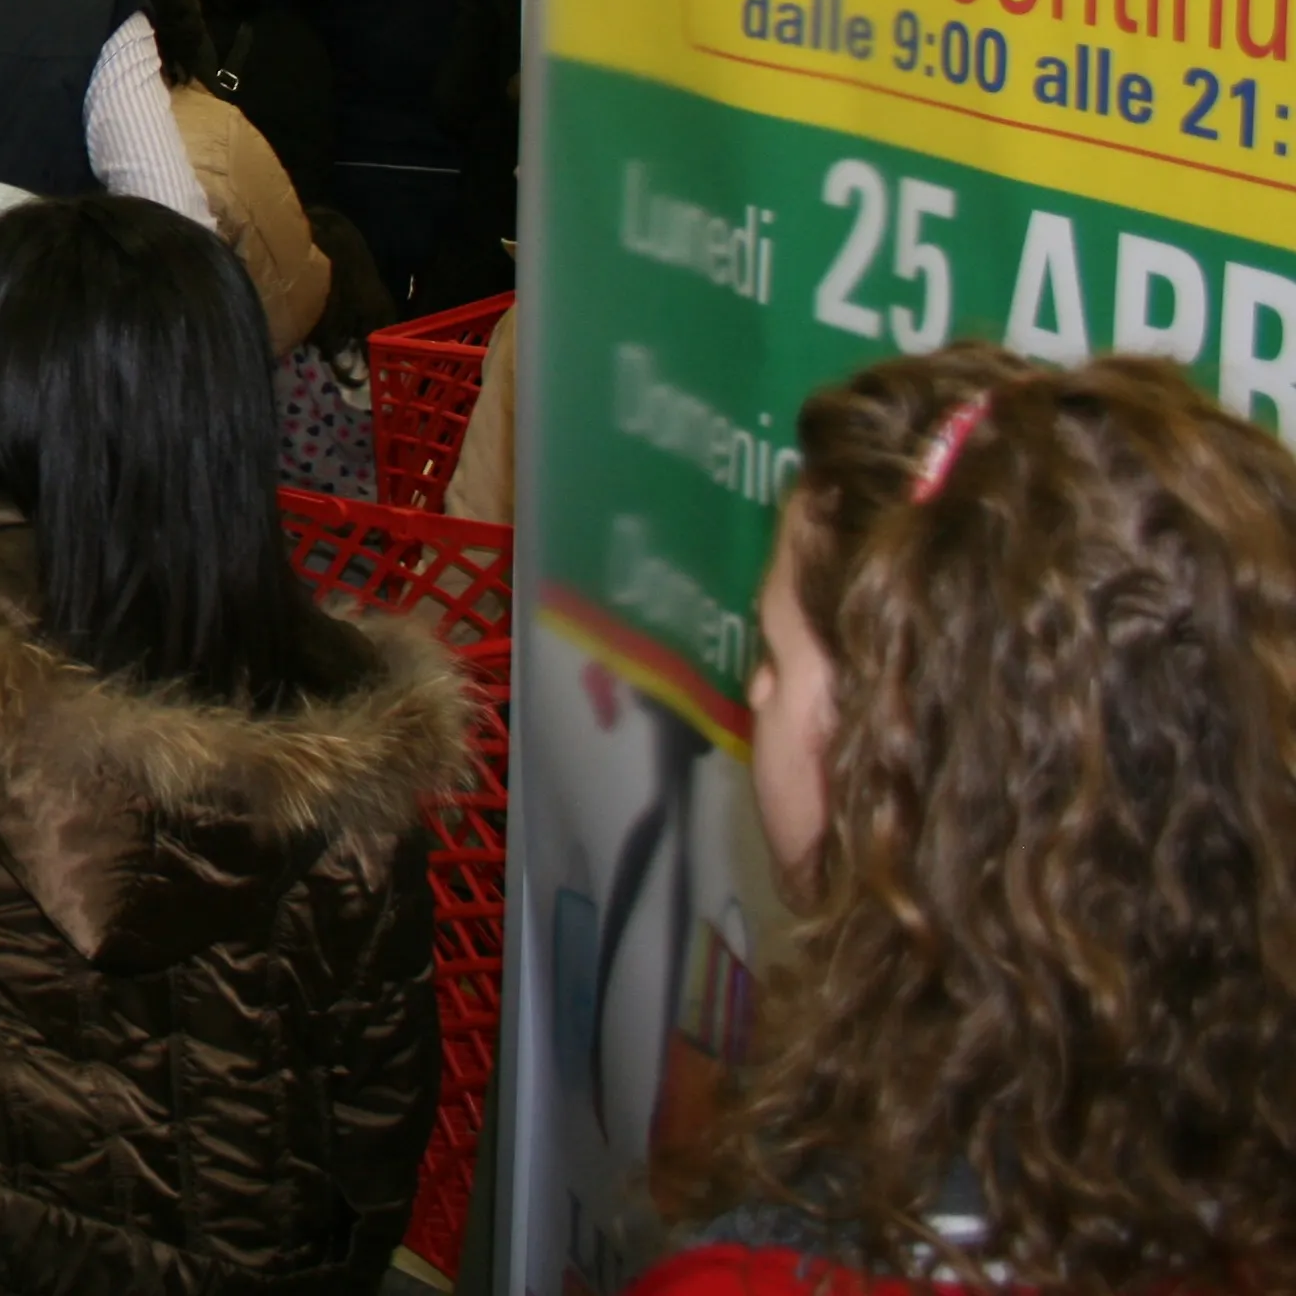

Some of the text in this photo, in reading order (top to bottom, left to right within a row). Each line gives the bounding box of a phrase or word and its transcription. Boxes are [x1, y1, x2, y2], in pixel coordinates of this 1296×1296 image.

[891, 9, 1010, 96] 9:00
[1033, 43, 1156, 126] alle
[814, 157, 958, 355] 25
